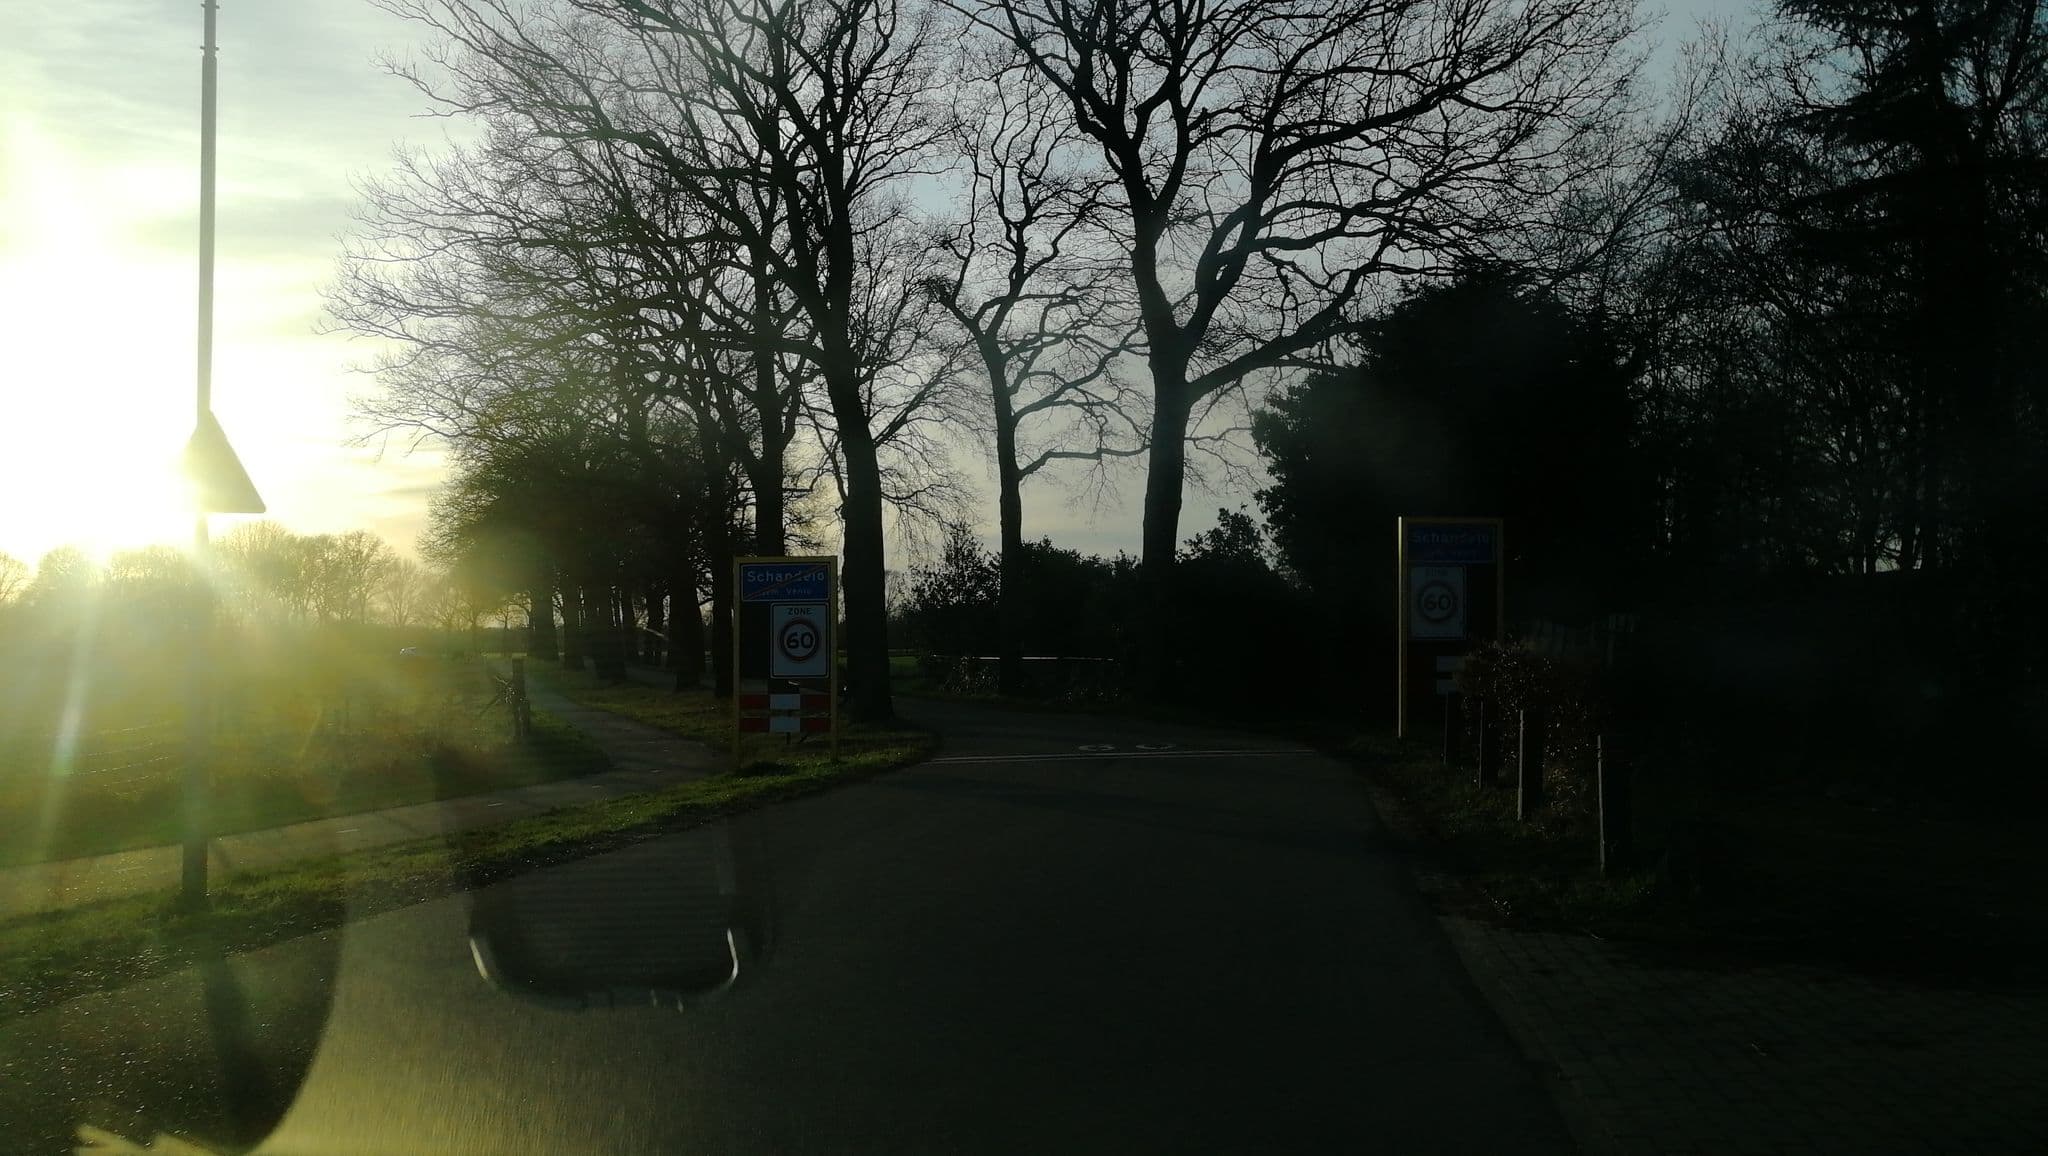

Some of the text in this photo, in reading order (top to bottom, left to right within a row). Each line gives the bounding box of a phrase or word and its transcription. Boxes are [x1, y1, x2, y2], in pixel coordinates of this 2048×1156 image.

[747, 570, 825, 583] Schandelo
[1425, 593, 1451, 611] 60
[787, 607, 813, 616] ZONE
[787, 632, 816, 650] 60
